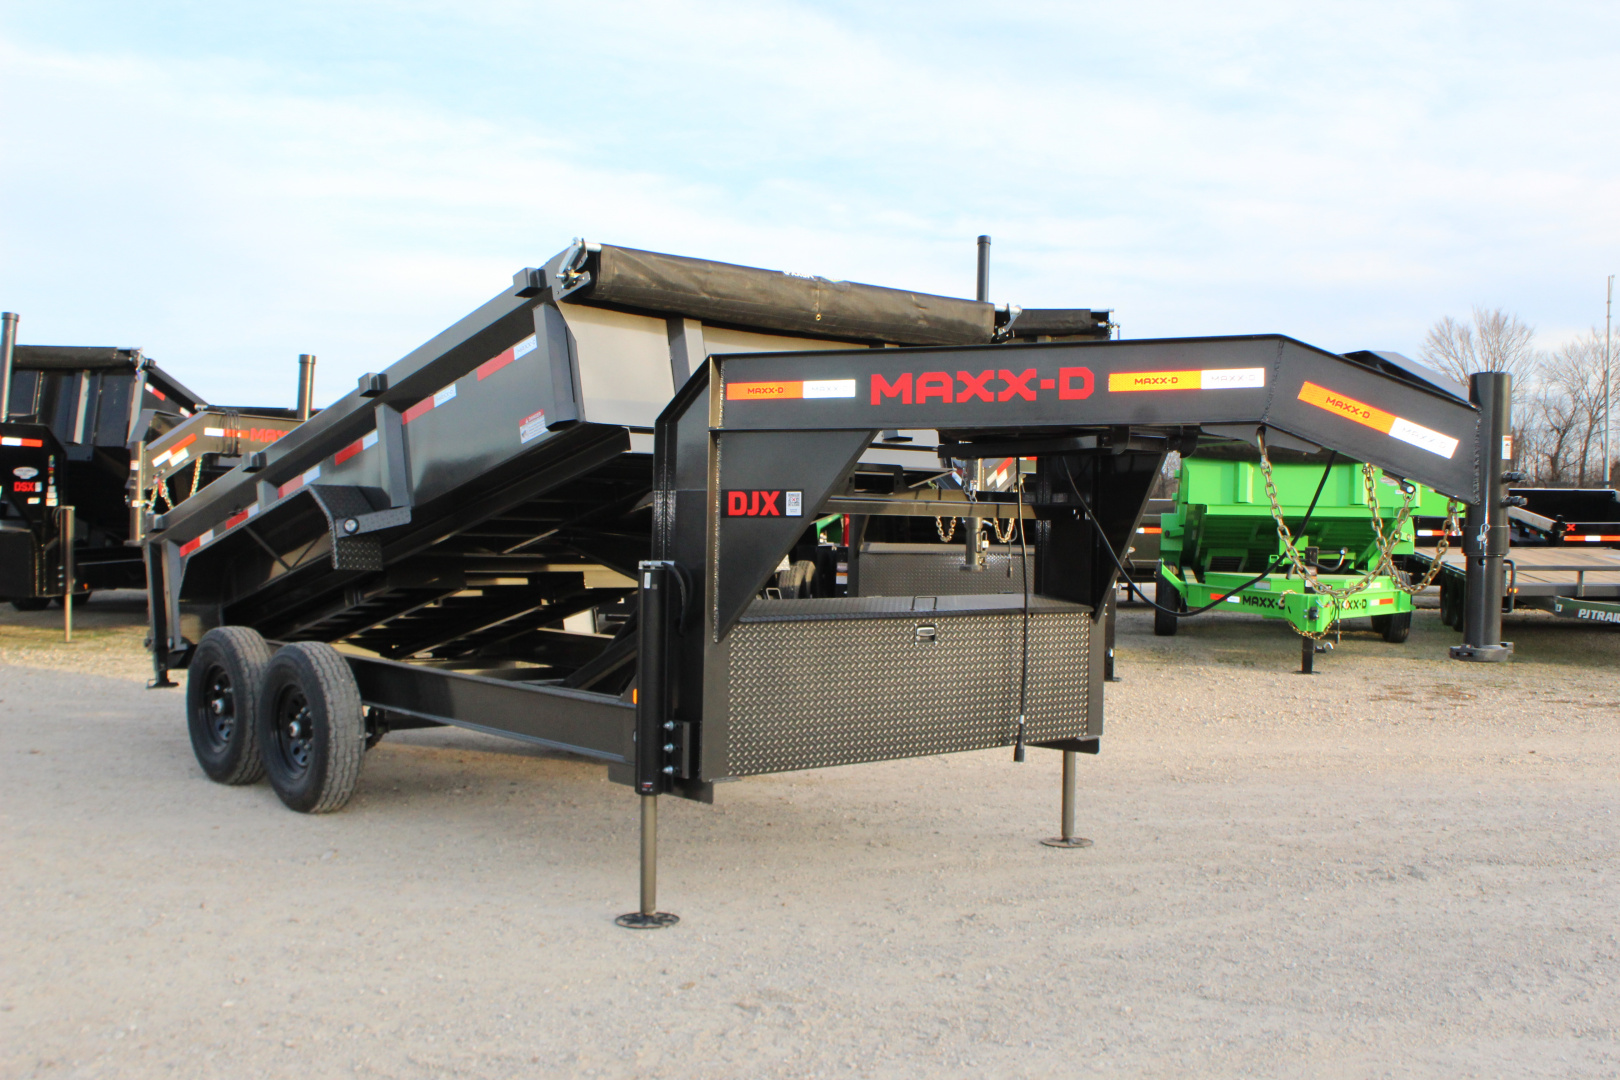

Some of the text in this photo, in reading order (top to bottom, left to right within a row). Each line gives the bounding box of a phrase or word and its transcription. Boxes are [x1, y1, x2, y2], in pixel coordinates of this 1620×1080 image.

[870, 367, 1095, 405] MAXX-D
[1134, 376, 1178, 385] MAXX-D
[747, 386, 784, 395] MAXX-D
[1325, 396, 1371, 419] MAXX-D
[13, 481, 35, 492] DSX
[728, 490, 780, 516] DJX
